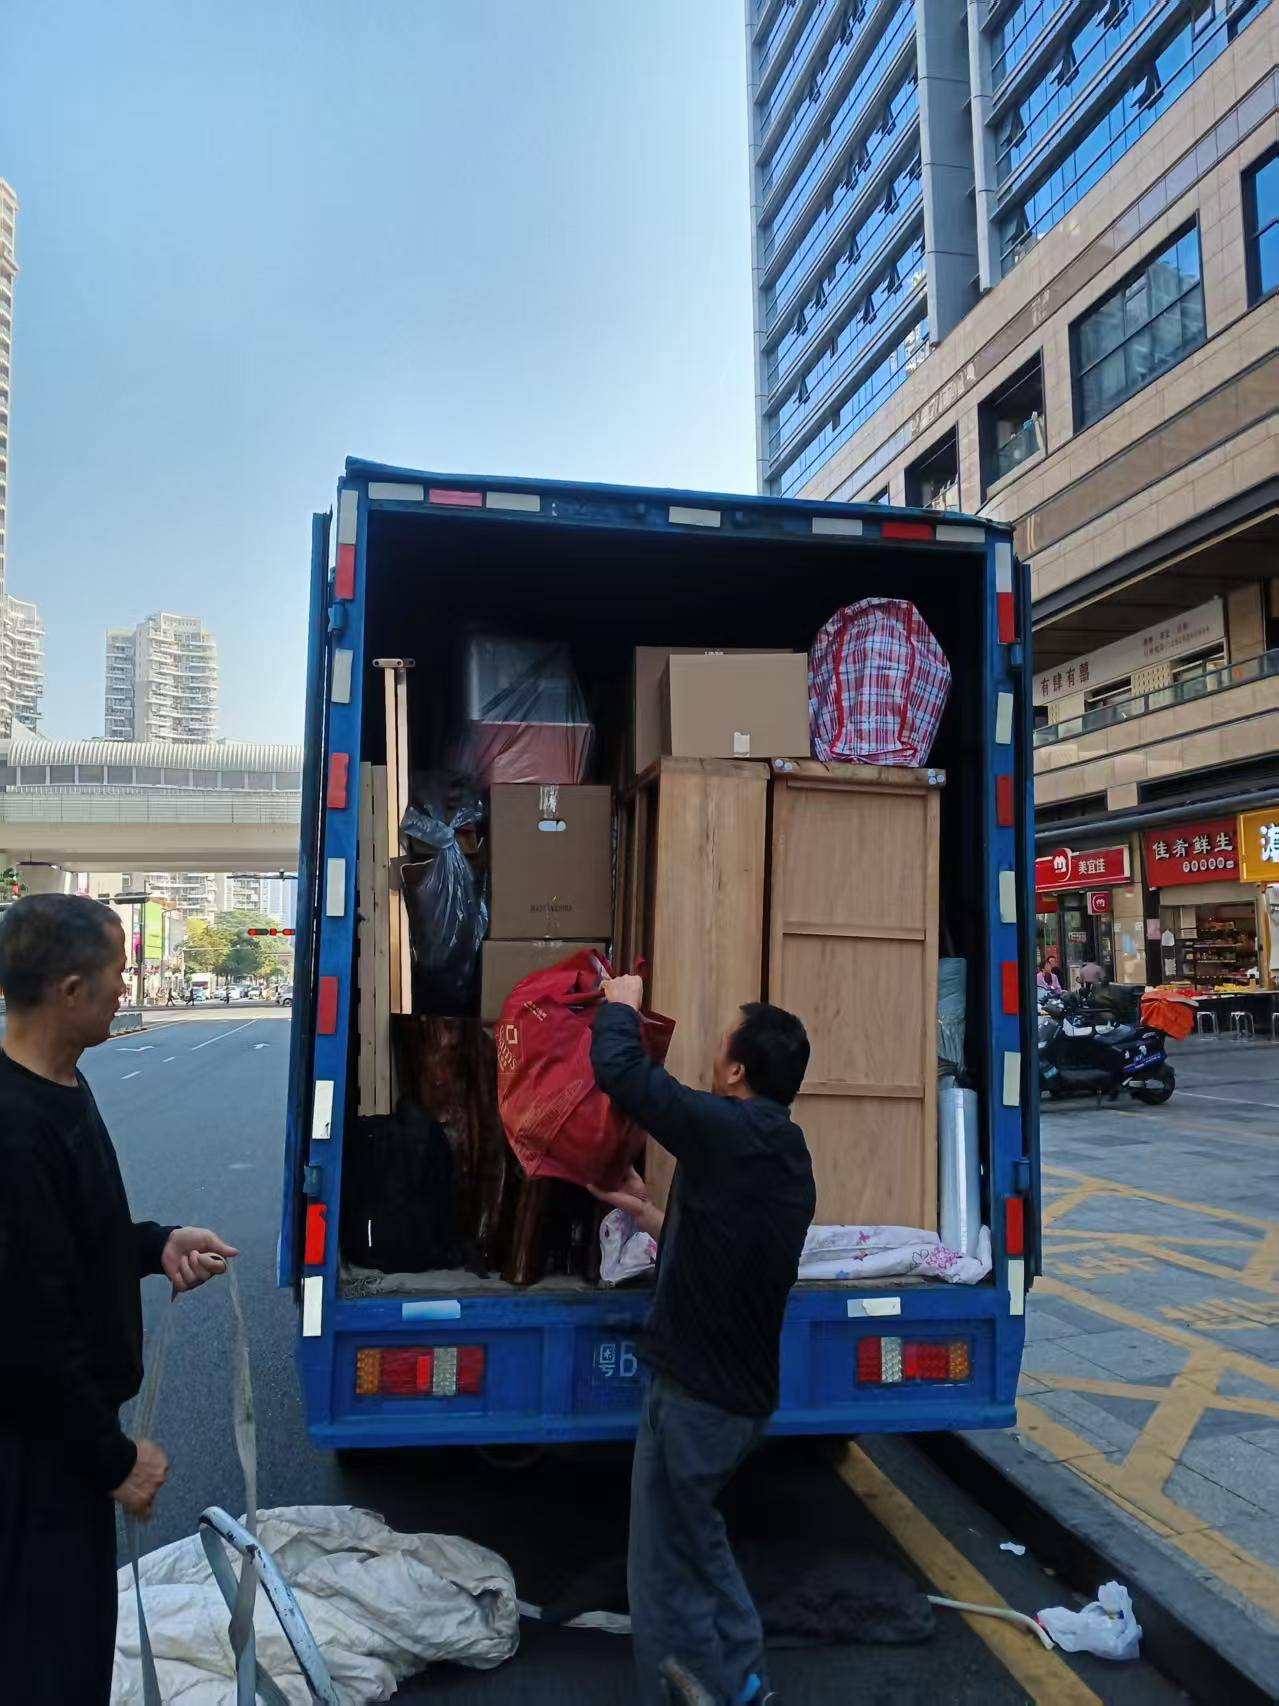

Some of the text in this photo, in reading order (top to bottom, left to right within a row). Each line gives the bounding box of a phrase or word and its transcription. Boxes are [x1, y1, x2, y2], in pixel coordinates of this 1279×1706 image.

[1152, 832, 1233, 860] 佳肴鲜生
[1078, 858, 1105, 875] 美宜佳
